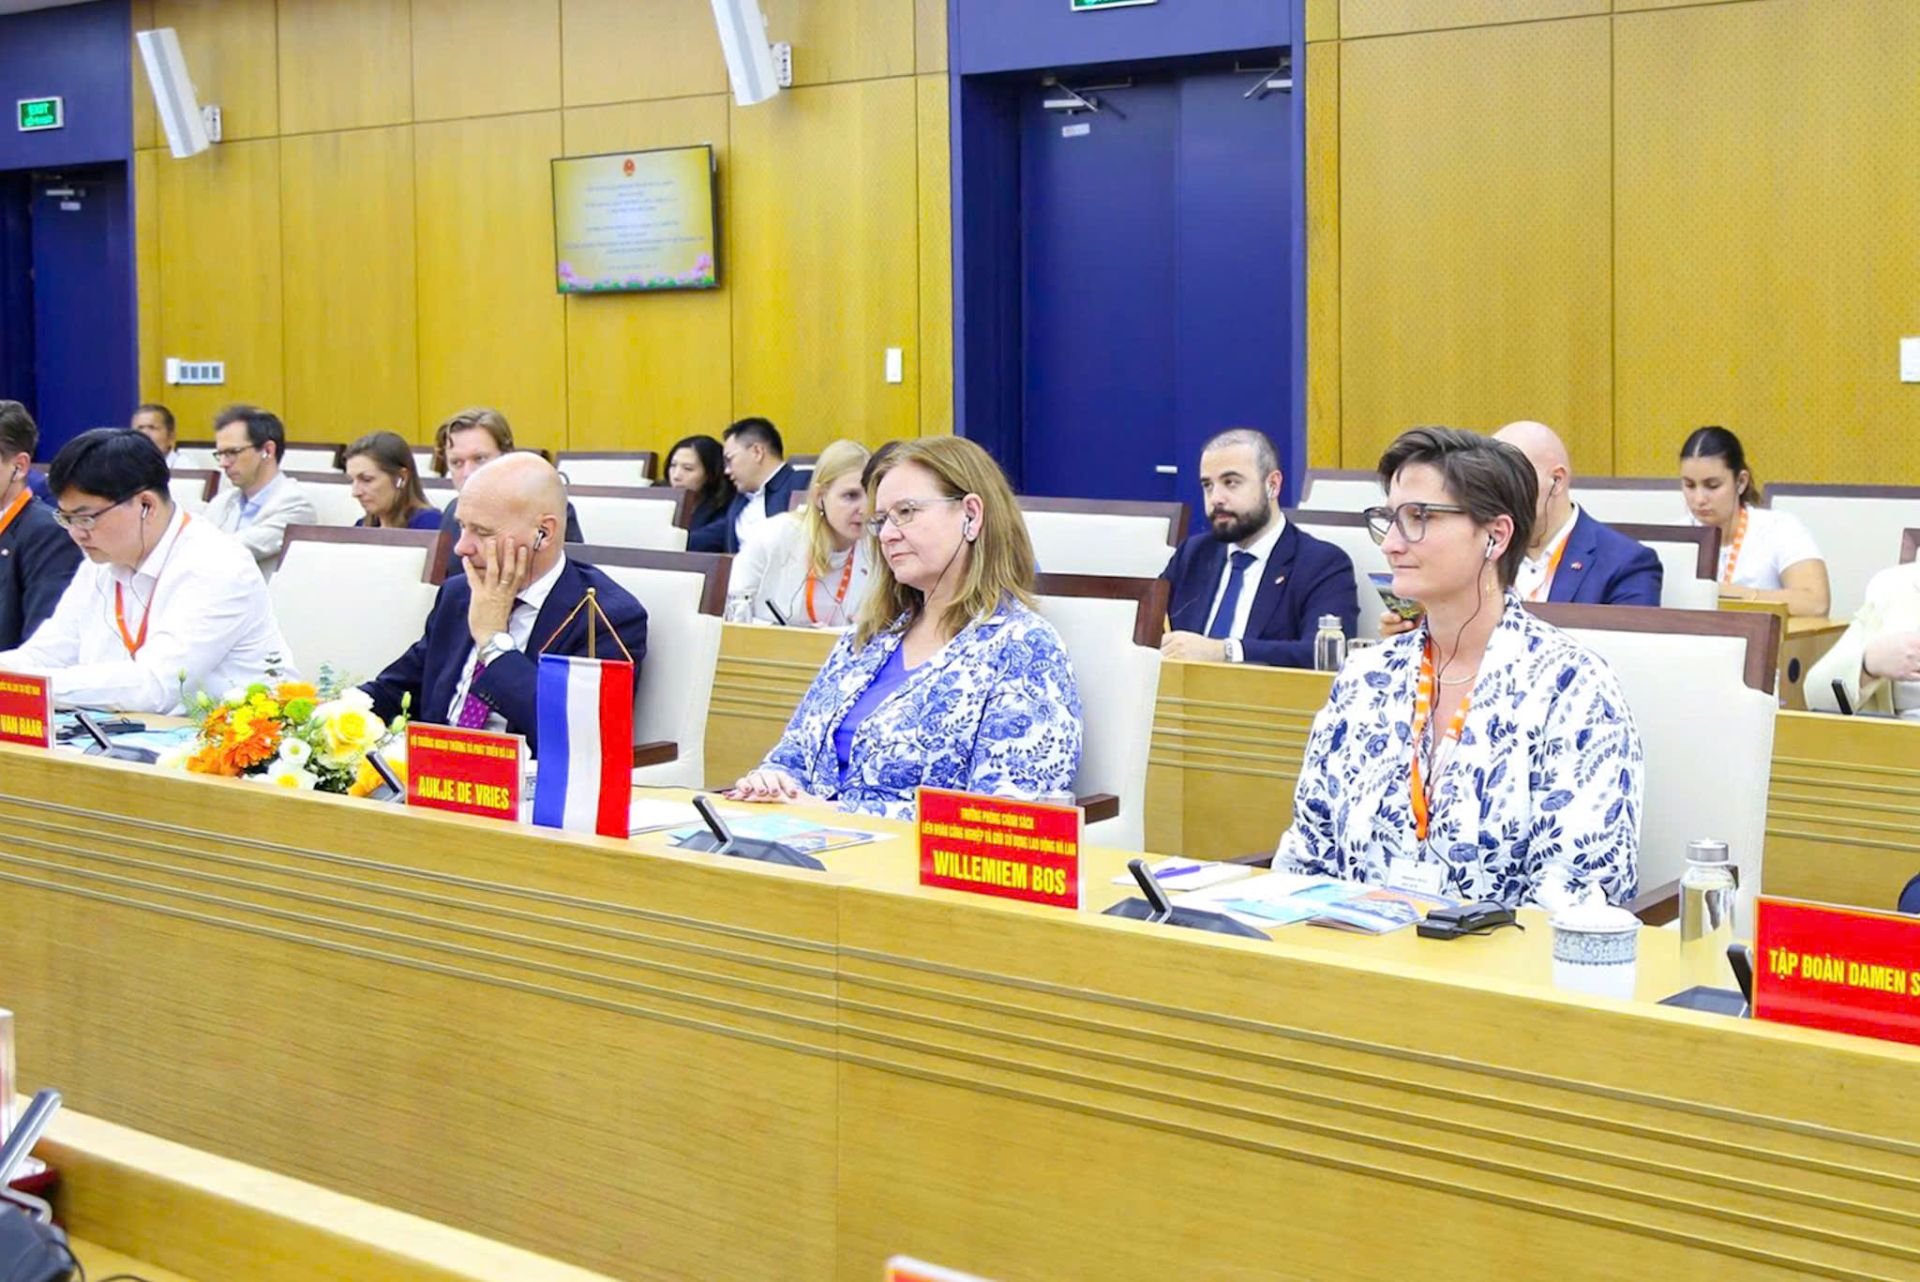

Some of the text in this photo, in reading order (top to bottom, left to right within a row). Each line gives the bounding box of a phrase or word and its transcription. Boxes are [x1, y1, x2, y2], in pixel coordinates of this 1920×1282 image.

[418, 775, 510, 810] AUKJE DE VRIES
[933, 849, 1067, 896] WILLEMIEM BOS
[1769, 946, 1798, 980] TẬP
[1802, 953, 1845, 983] ĐOÀN
[1849, 962, 1906, 994] DAMEN
